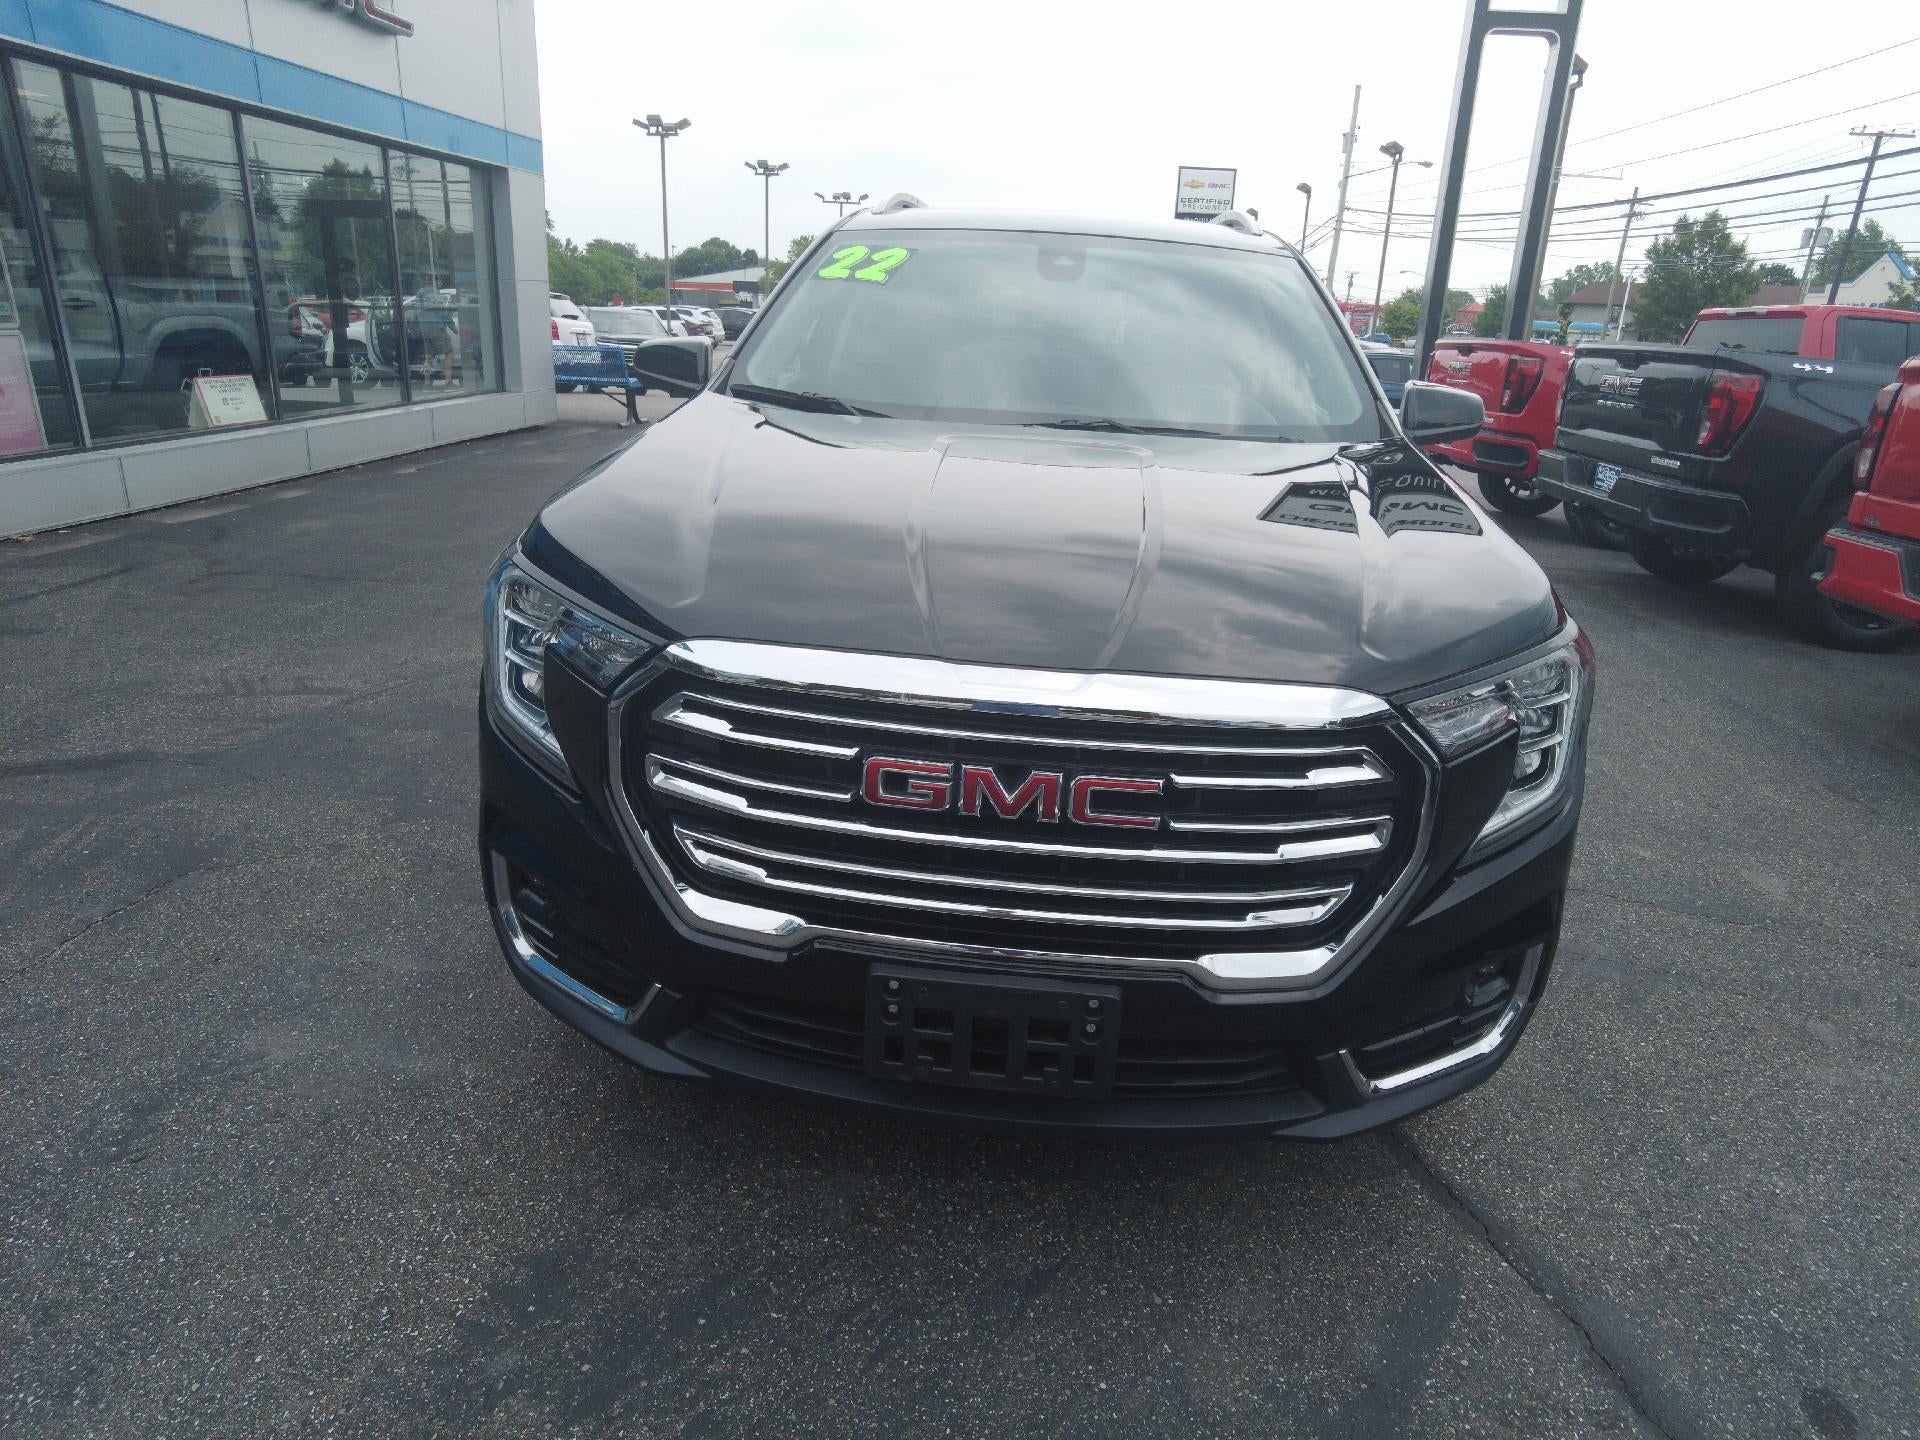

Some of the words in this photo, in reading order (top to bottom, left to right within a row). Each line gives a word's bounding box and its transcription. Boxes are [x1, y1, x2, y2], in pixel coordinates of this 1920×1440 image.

[1180, 197, 1231, 205] CERTIFIED
[819, 245, 910, 284] 22
[1600, 374, 1644, 395] GMC
[859, 756, 1165, 830] GMC
